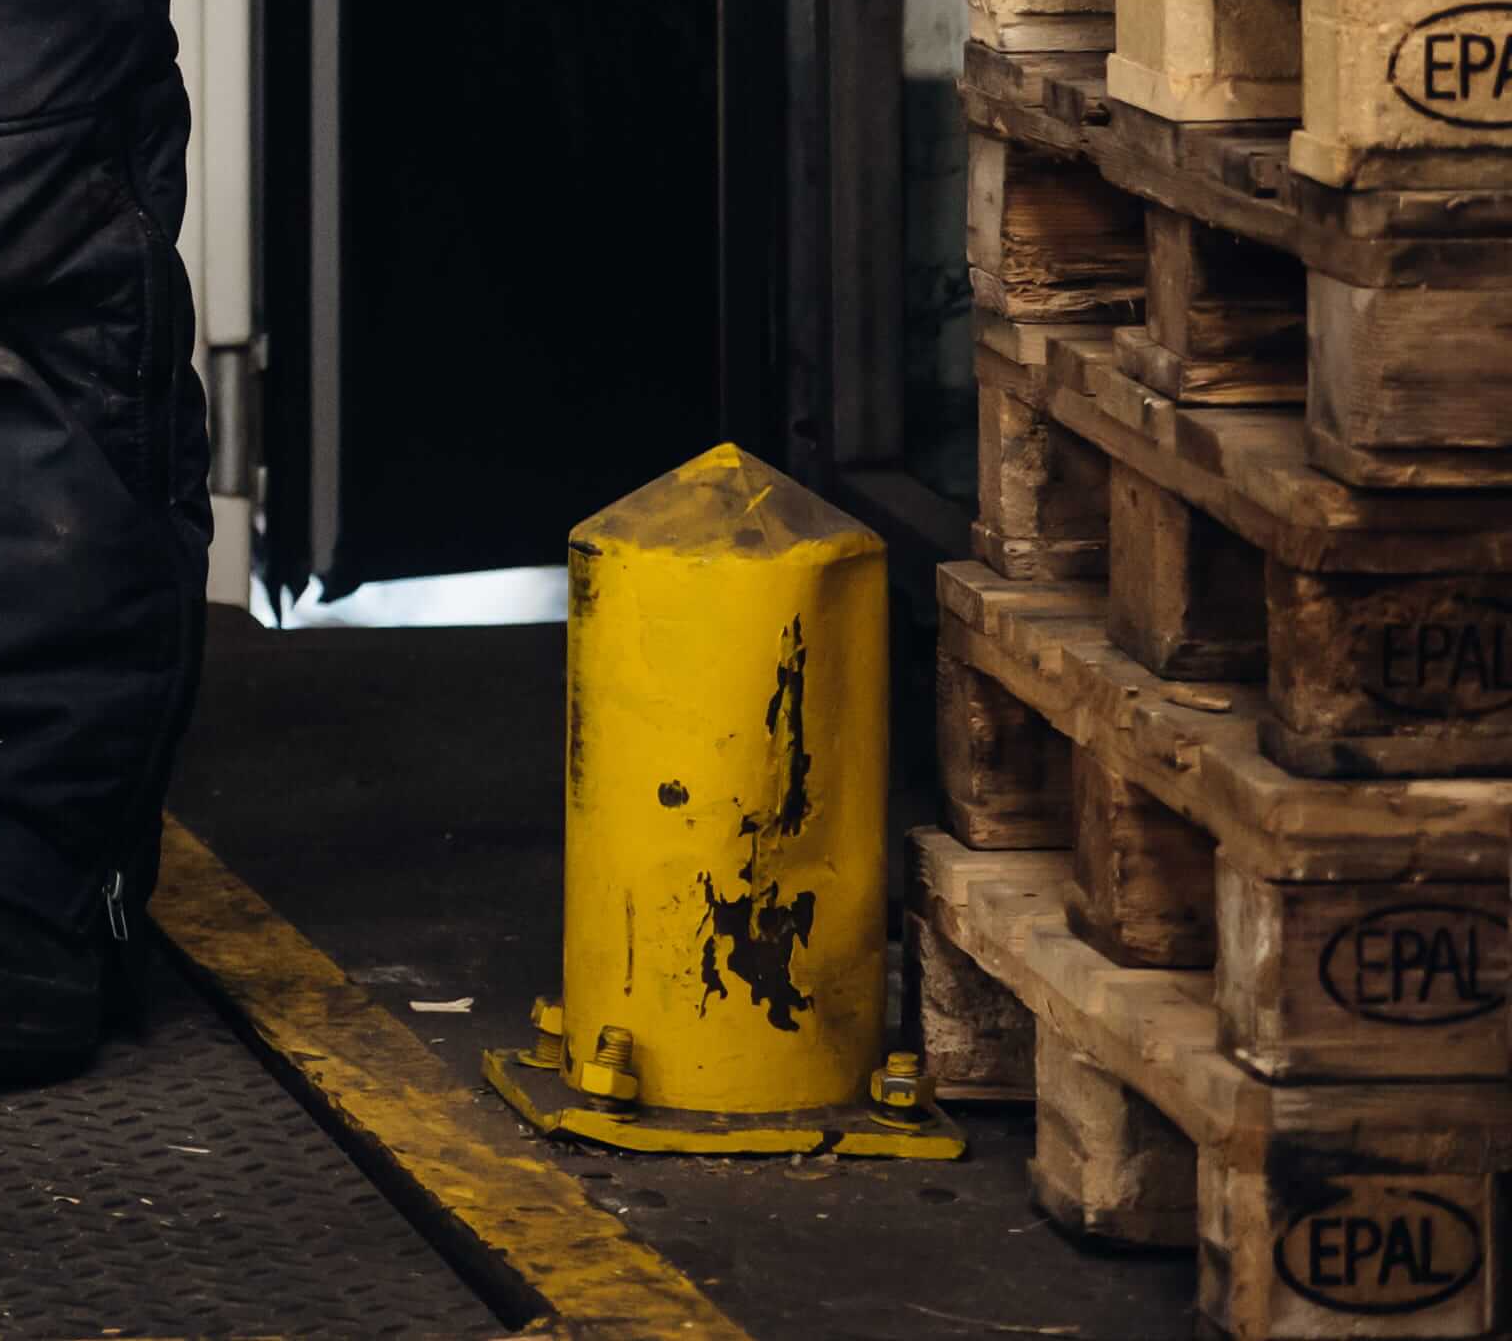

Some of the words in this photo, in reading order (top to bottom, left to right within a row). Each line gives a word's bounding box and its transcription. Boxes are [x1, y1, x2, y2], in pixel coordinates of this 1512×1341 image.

[1424, 33, 1512, 101] EPA
[1354, 923, 1494, 1004] EPAL
[1309, 1215, 1454, 1286] EPAL
